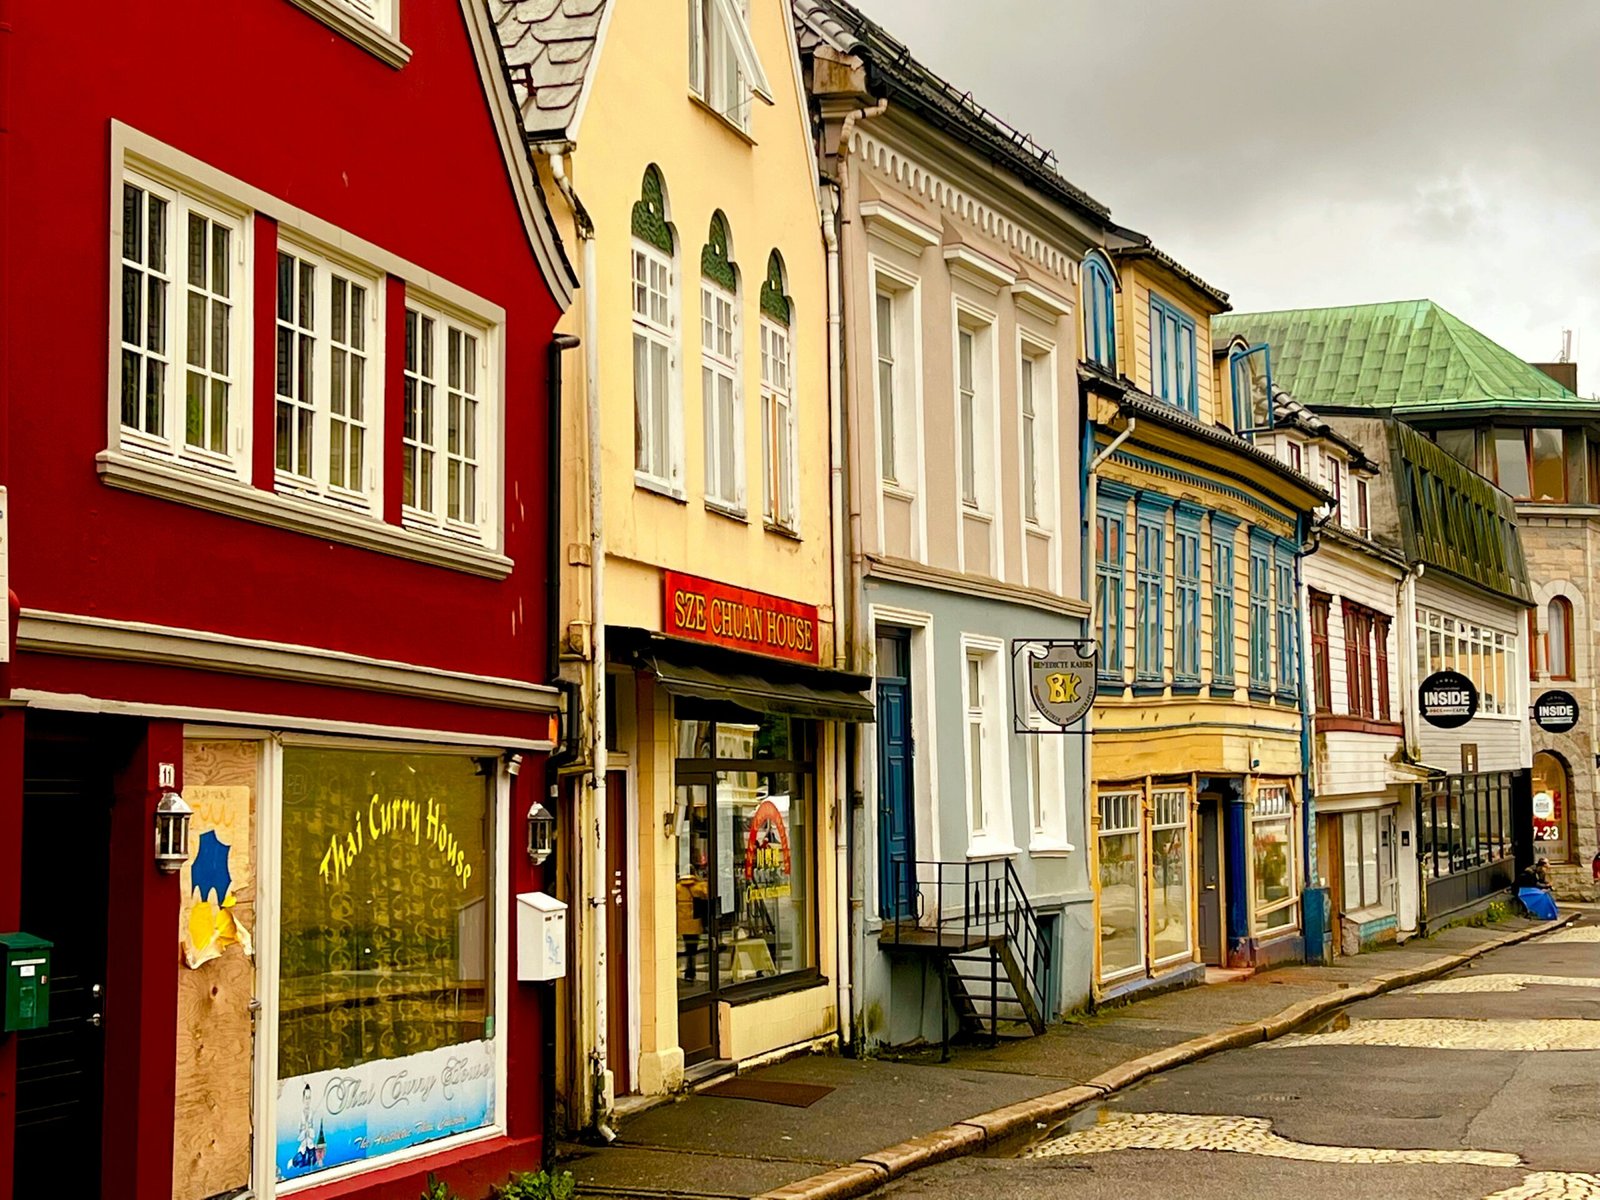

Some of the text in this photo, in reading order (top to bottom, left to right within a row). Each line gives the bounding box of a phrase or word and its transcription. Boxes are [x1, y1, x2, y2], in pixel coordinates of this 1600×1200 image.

[675, 590, 813, 651] SZE CHUAN HOUSE
[1045, 672, 1082, 704] BK
[1424, 691, 1470, 706] INSIDE
[1538, 705, 1574, 717] INSIDE
[163, 766, 172, 783] 11
[319, 810, 363, 884] Thai
[369, 793, 421, 846] Curry
[324, 1056, 491, 1115] Thai Curry House
